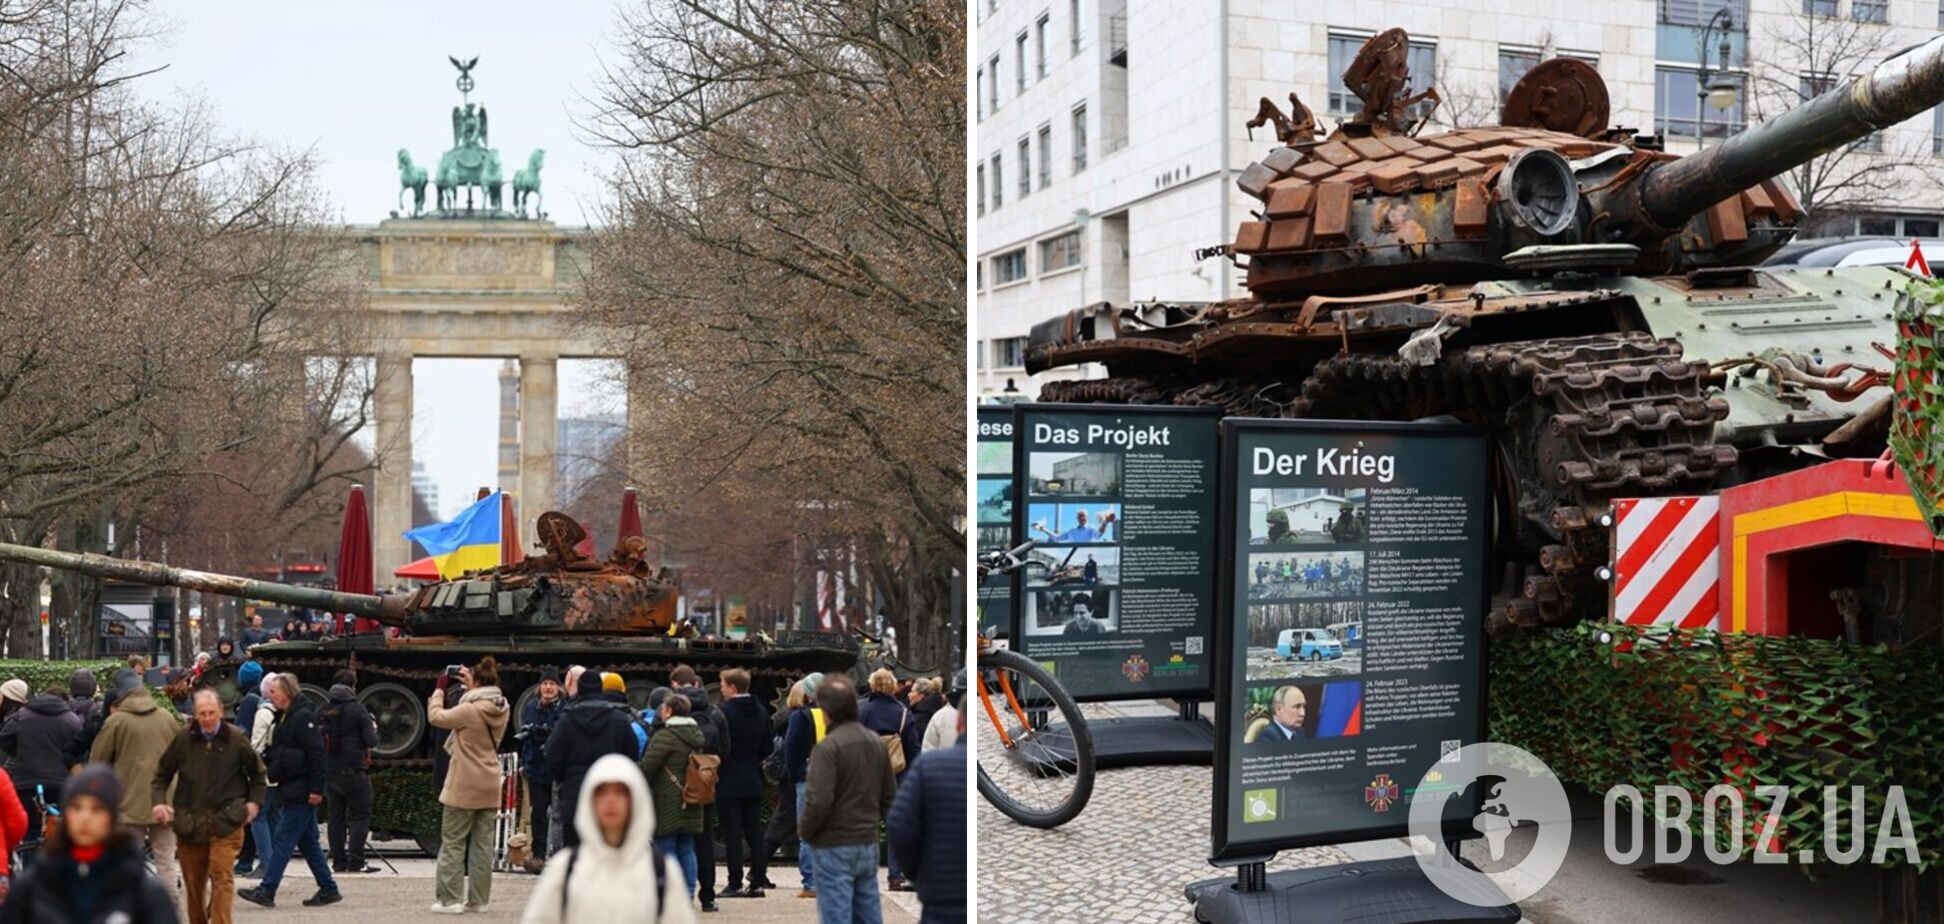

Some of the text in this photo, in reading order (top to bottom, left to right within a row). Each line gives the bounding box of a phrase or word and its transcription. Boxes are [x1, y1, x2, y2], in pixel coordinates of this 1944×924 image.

[1034, 423, 1170, 449] Das Projekt
[1252, 447, 1395, 482] Der Krieg
